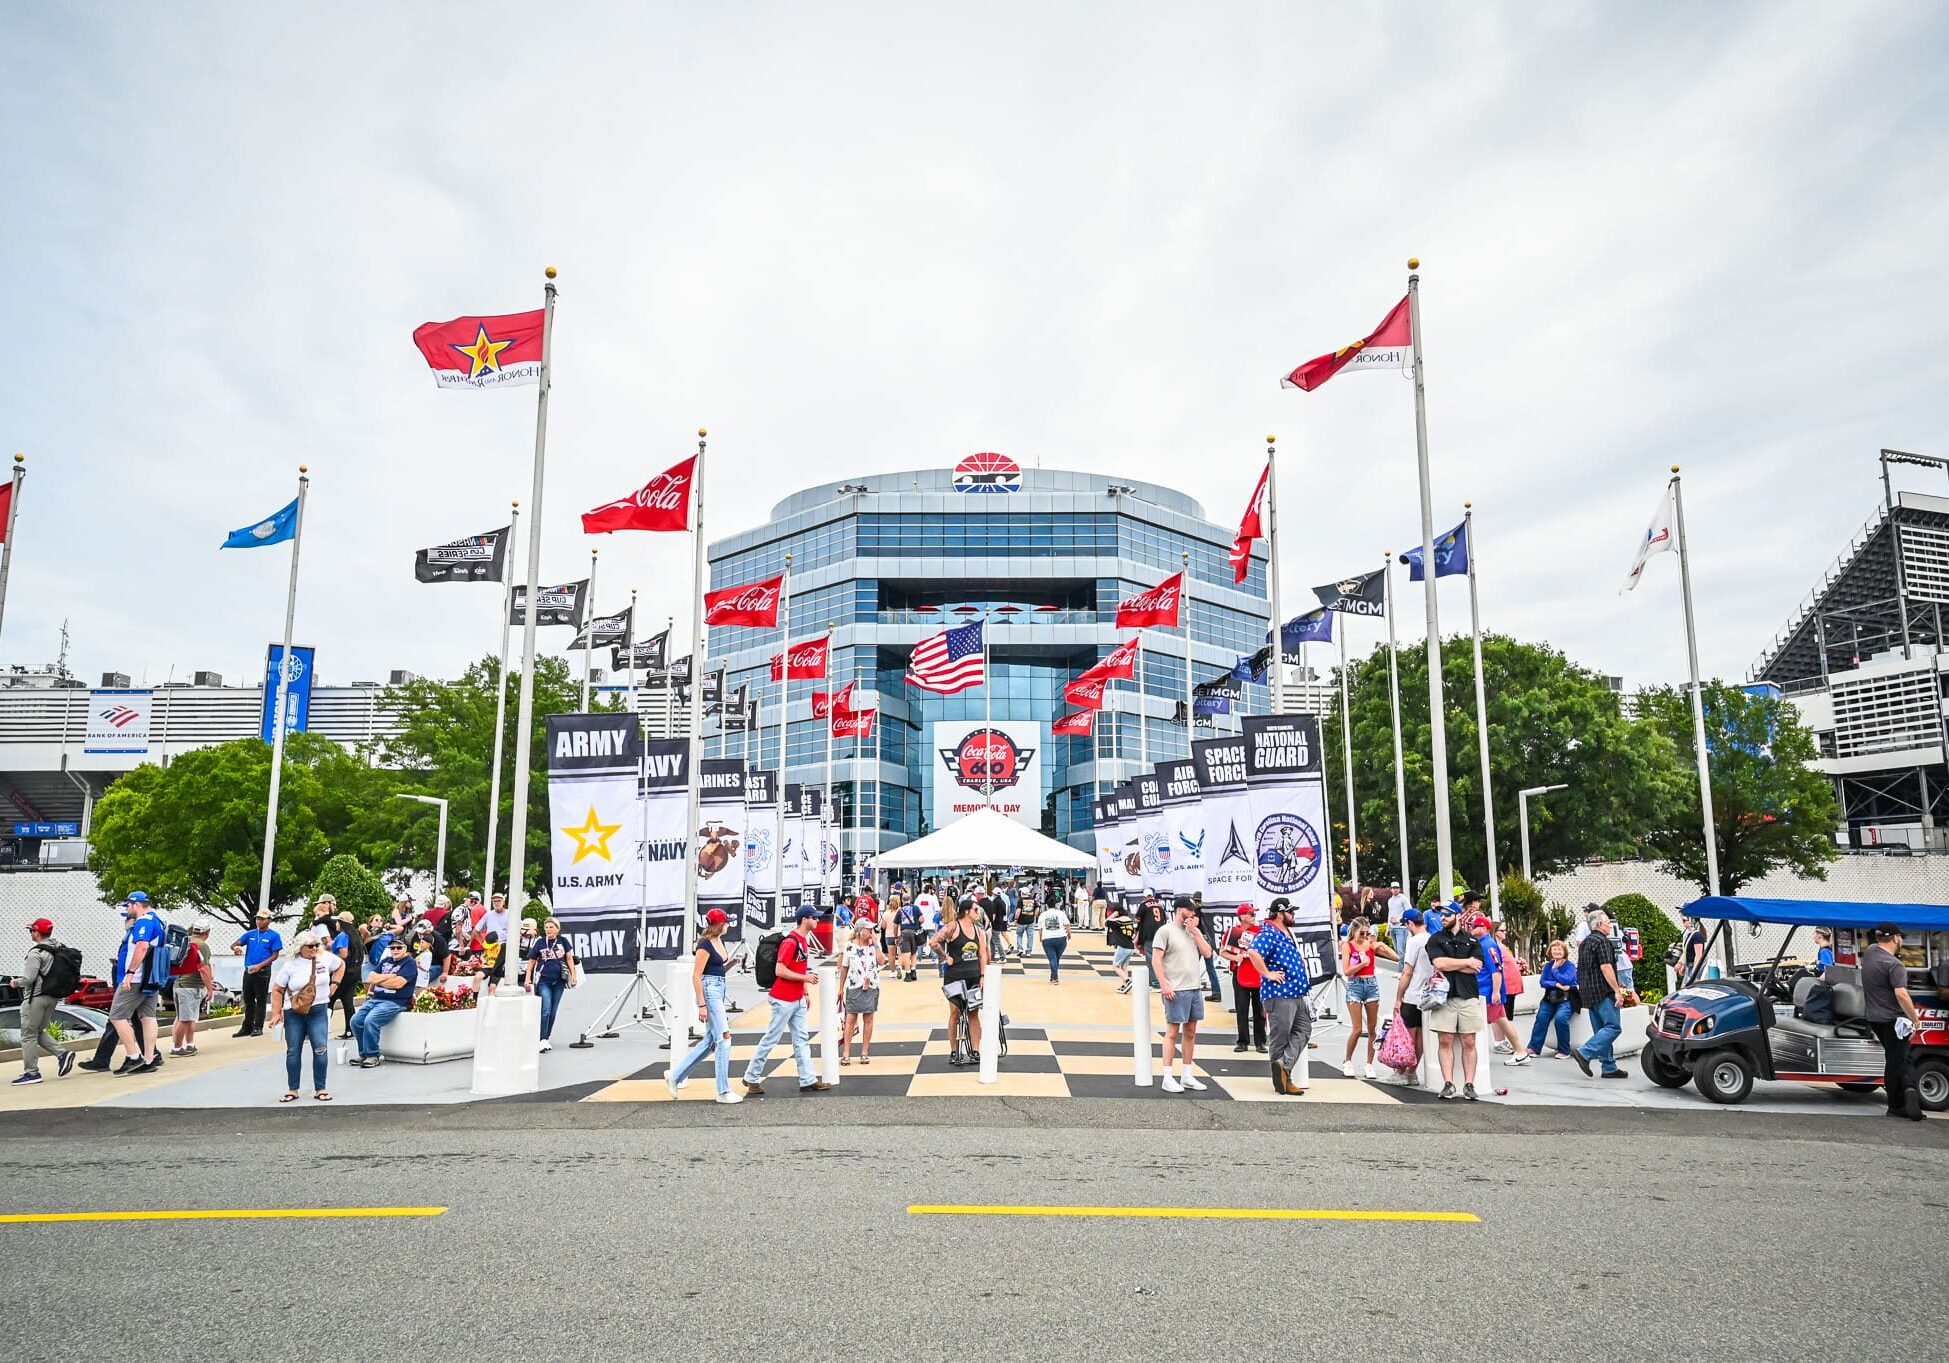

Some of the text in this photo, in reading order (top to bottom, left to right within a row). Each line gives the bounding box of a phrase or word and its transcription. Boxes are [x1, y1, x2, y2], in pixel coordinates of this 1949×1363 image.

[555, 730, 627, 757] ARMY
[1255, 731, 1308, 748] NATIONAL
[1255, 746, 1309, 769] GUARD
[970, 762, 1005, 775] 600
[1174, 766, 1195, 781] AIR
[698, 773, 740, 788] ARINES
[745, 776, 766, 789] AST
[745, 789, 767, 802] ARD
[953, 804, 1021, 812] MEMOAL DAY
[648, 842, 687, 861] NAVY
[558, 873, 624, 887] U.S. ARMY
[1208, 877, 1232, 885] SPACE
[1236, 875, 1252, 883] FOR
[1153, 907, 1161, 922] 9
